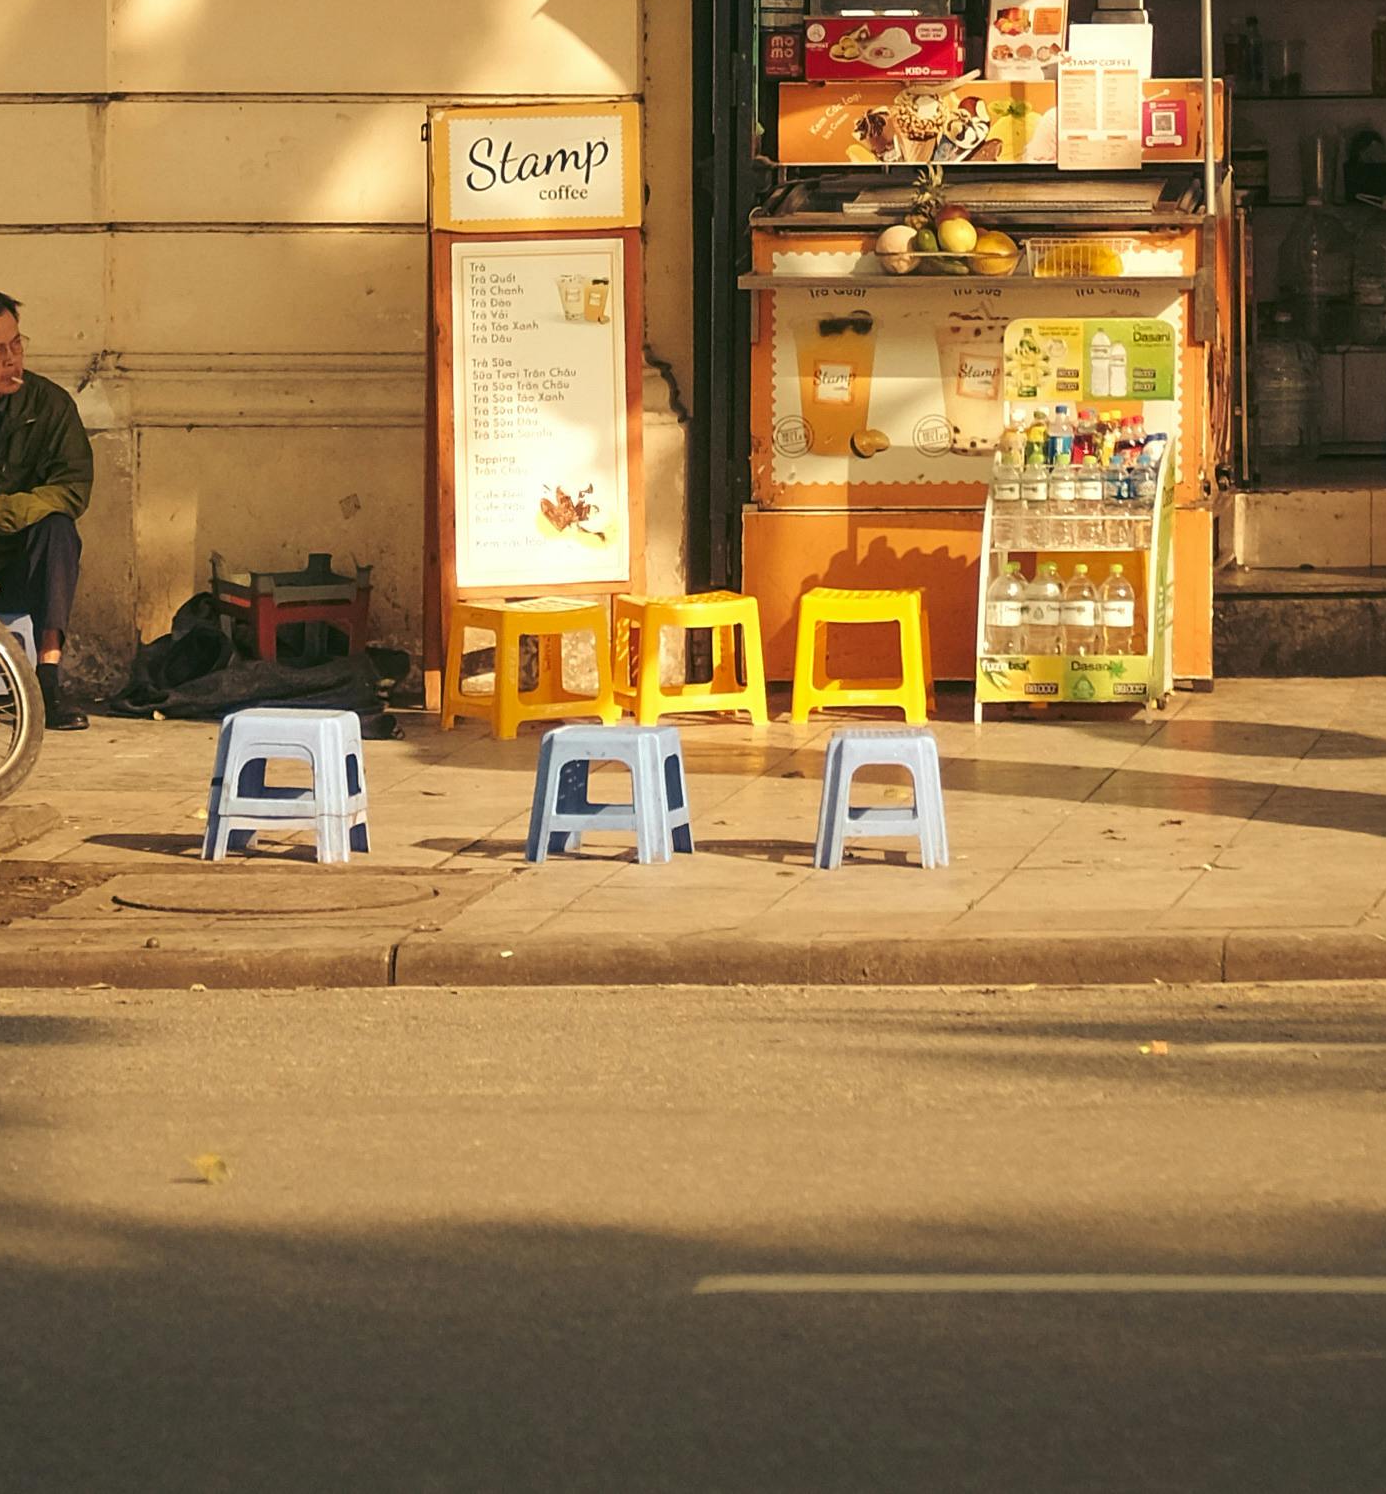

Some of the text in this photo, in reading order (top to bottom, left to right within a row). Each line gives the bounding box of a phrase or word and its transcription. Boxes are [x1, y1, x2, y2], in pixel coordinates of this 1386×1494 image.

[905, 66, 930, 75] KIDO
[466, 137, 609, 192] Stamp
[539, 185, 588, 200] coffee
[470, 262, 486, 272] Trà
[490, 285, 524, 296] Chanh
[1132, 331, 1171, 343] Dasani
[813, 369, 857, 387] Stamp
[474, 454, 516, 465] Topping
[1070, 660, 1114, 671] Dasan
